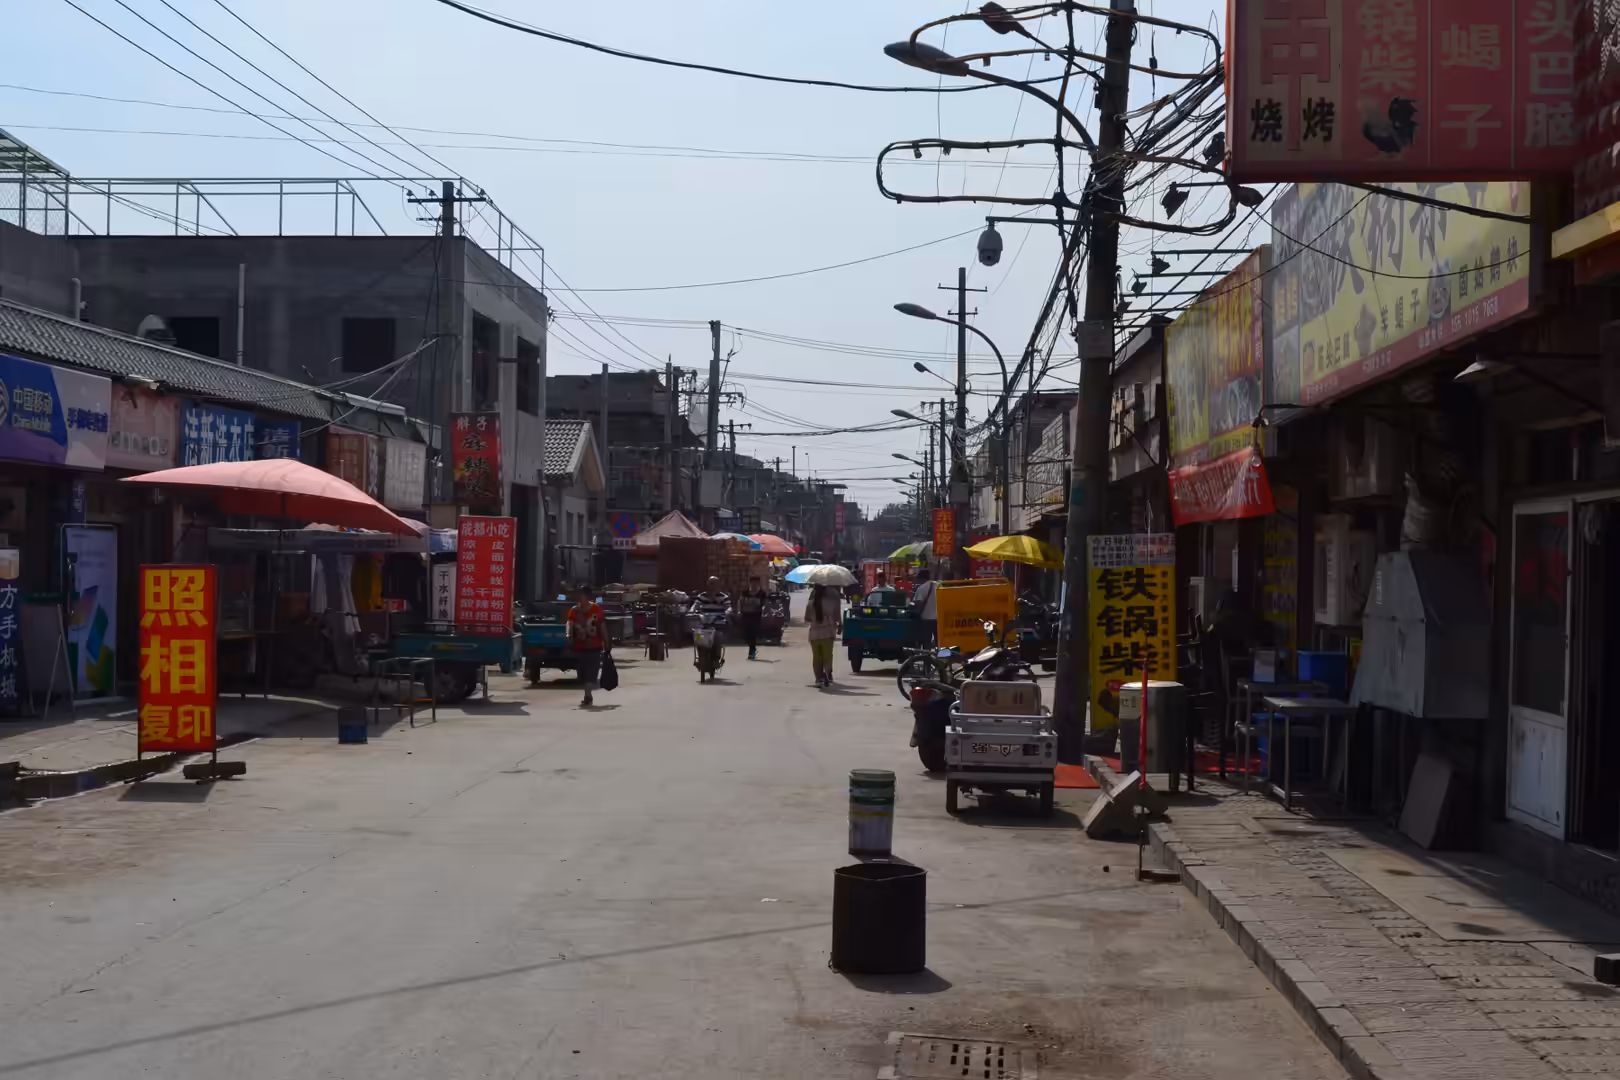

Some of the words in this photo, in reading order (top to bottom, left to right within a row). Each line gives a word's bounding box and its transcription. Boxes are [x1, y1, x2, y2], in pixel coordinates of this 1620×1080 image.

[1250, 97, 1335, 143] 烧烤
[13, 386, 53, 415] 中国移动
[461, 522, 510, 539] 成都小吃
[140, 569, 208, 694] 照相
[1096, 568, 1158, 676] 铁锅柴
[140, 703, 212, 744] 复印
